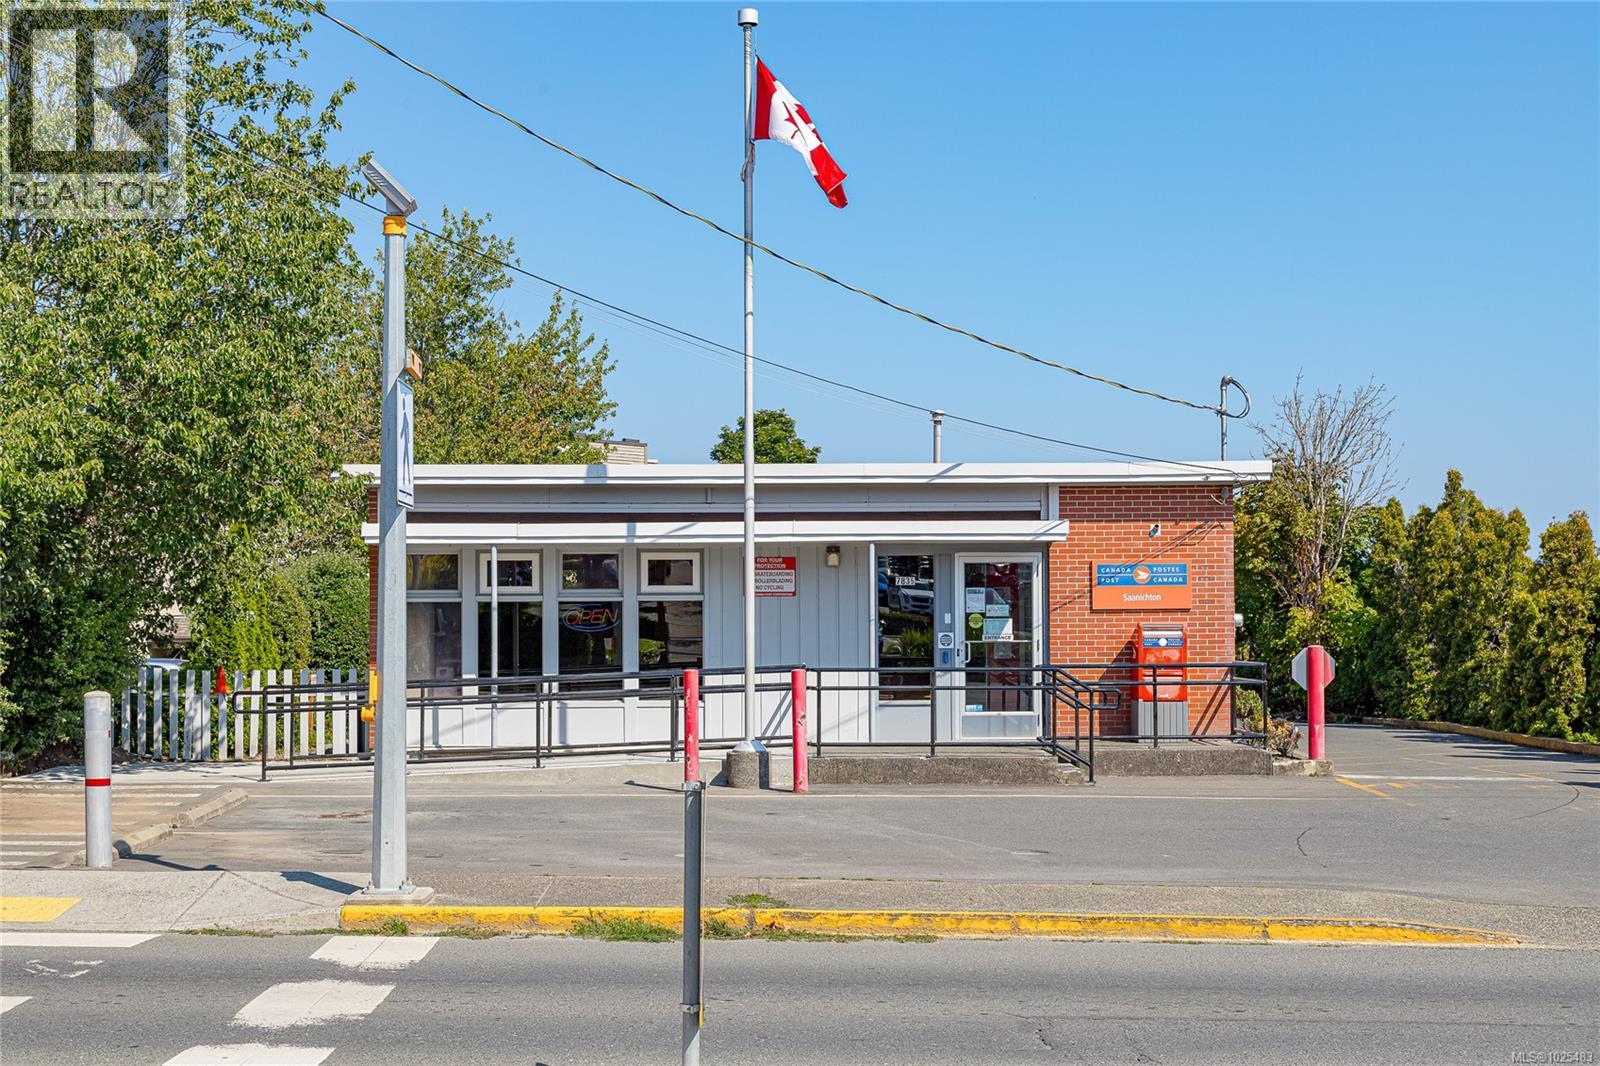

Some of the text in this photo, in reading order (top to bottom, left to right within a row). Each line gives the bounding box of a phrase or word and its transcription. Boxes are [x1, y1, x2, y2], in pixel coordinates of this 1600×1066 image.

[896, 577, 915, 585] 7835
[1123, 593, 1162, 602] Saanichton
[565, 608, 619, 625] OPEN
